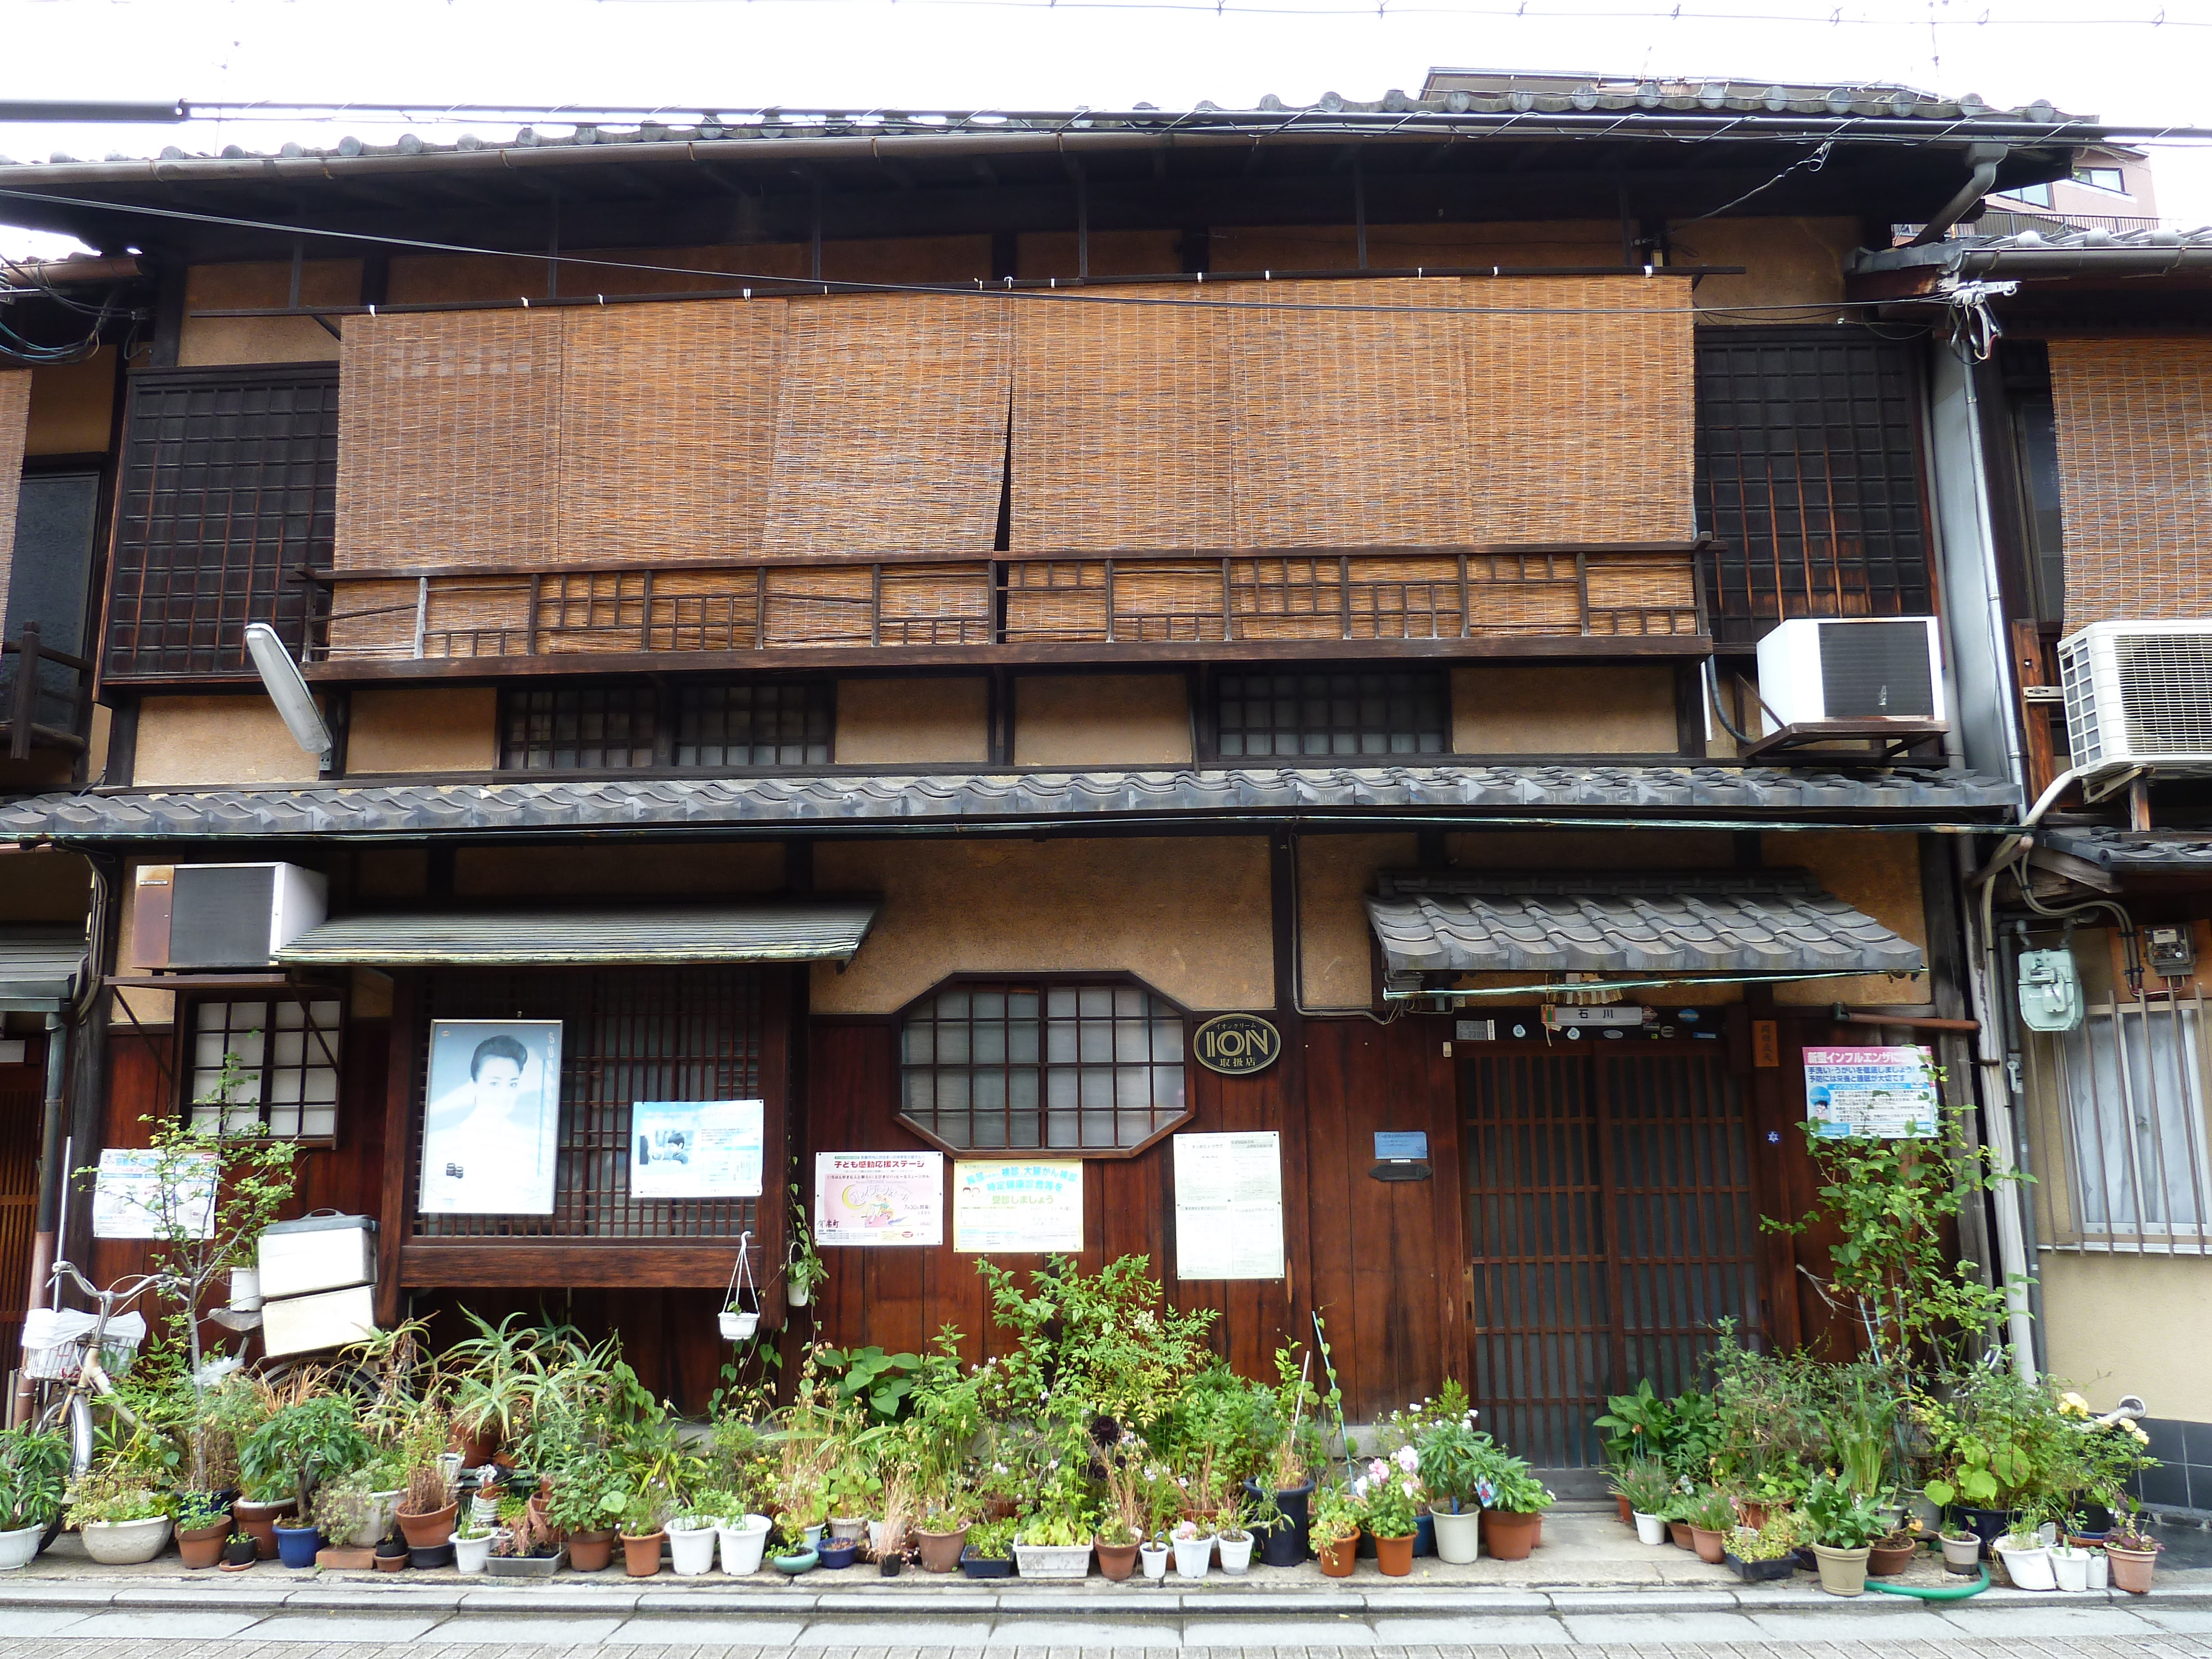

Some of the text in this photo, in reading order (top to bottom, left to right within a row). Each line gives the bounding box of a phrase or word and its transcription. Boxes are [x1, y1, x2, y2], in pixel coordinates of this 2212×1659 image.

[1578, 1009, 1614, 1019] 石川
[1206, 1029, 1269, 1057] ION
[1219, 1057, 1256, 1067] 取扱店
[834, 1160, 925, 1168] 子ども感動応援ステージ
[992, 1195, 1054, 1204] 受診しましょう
